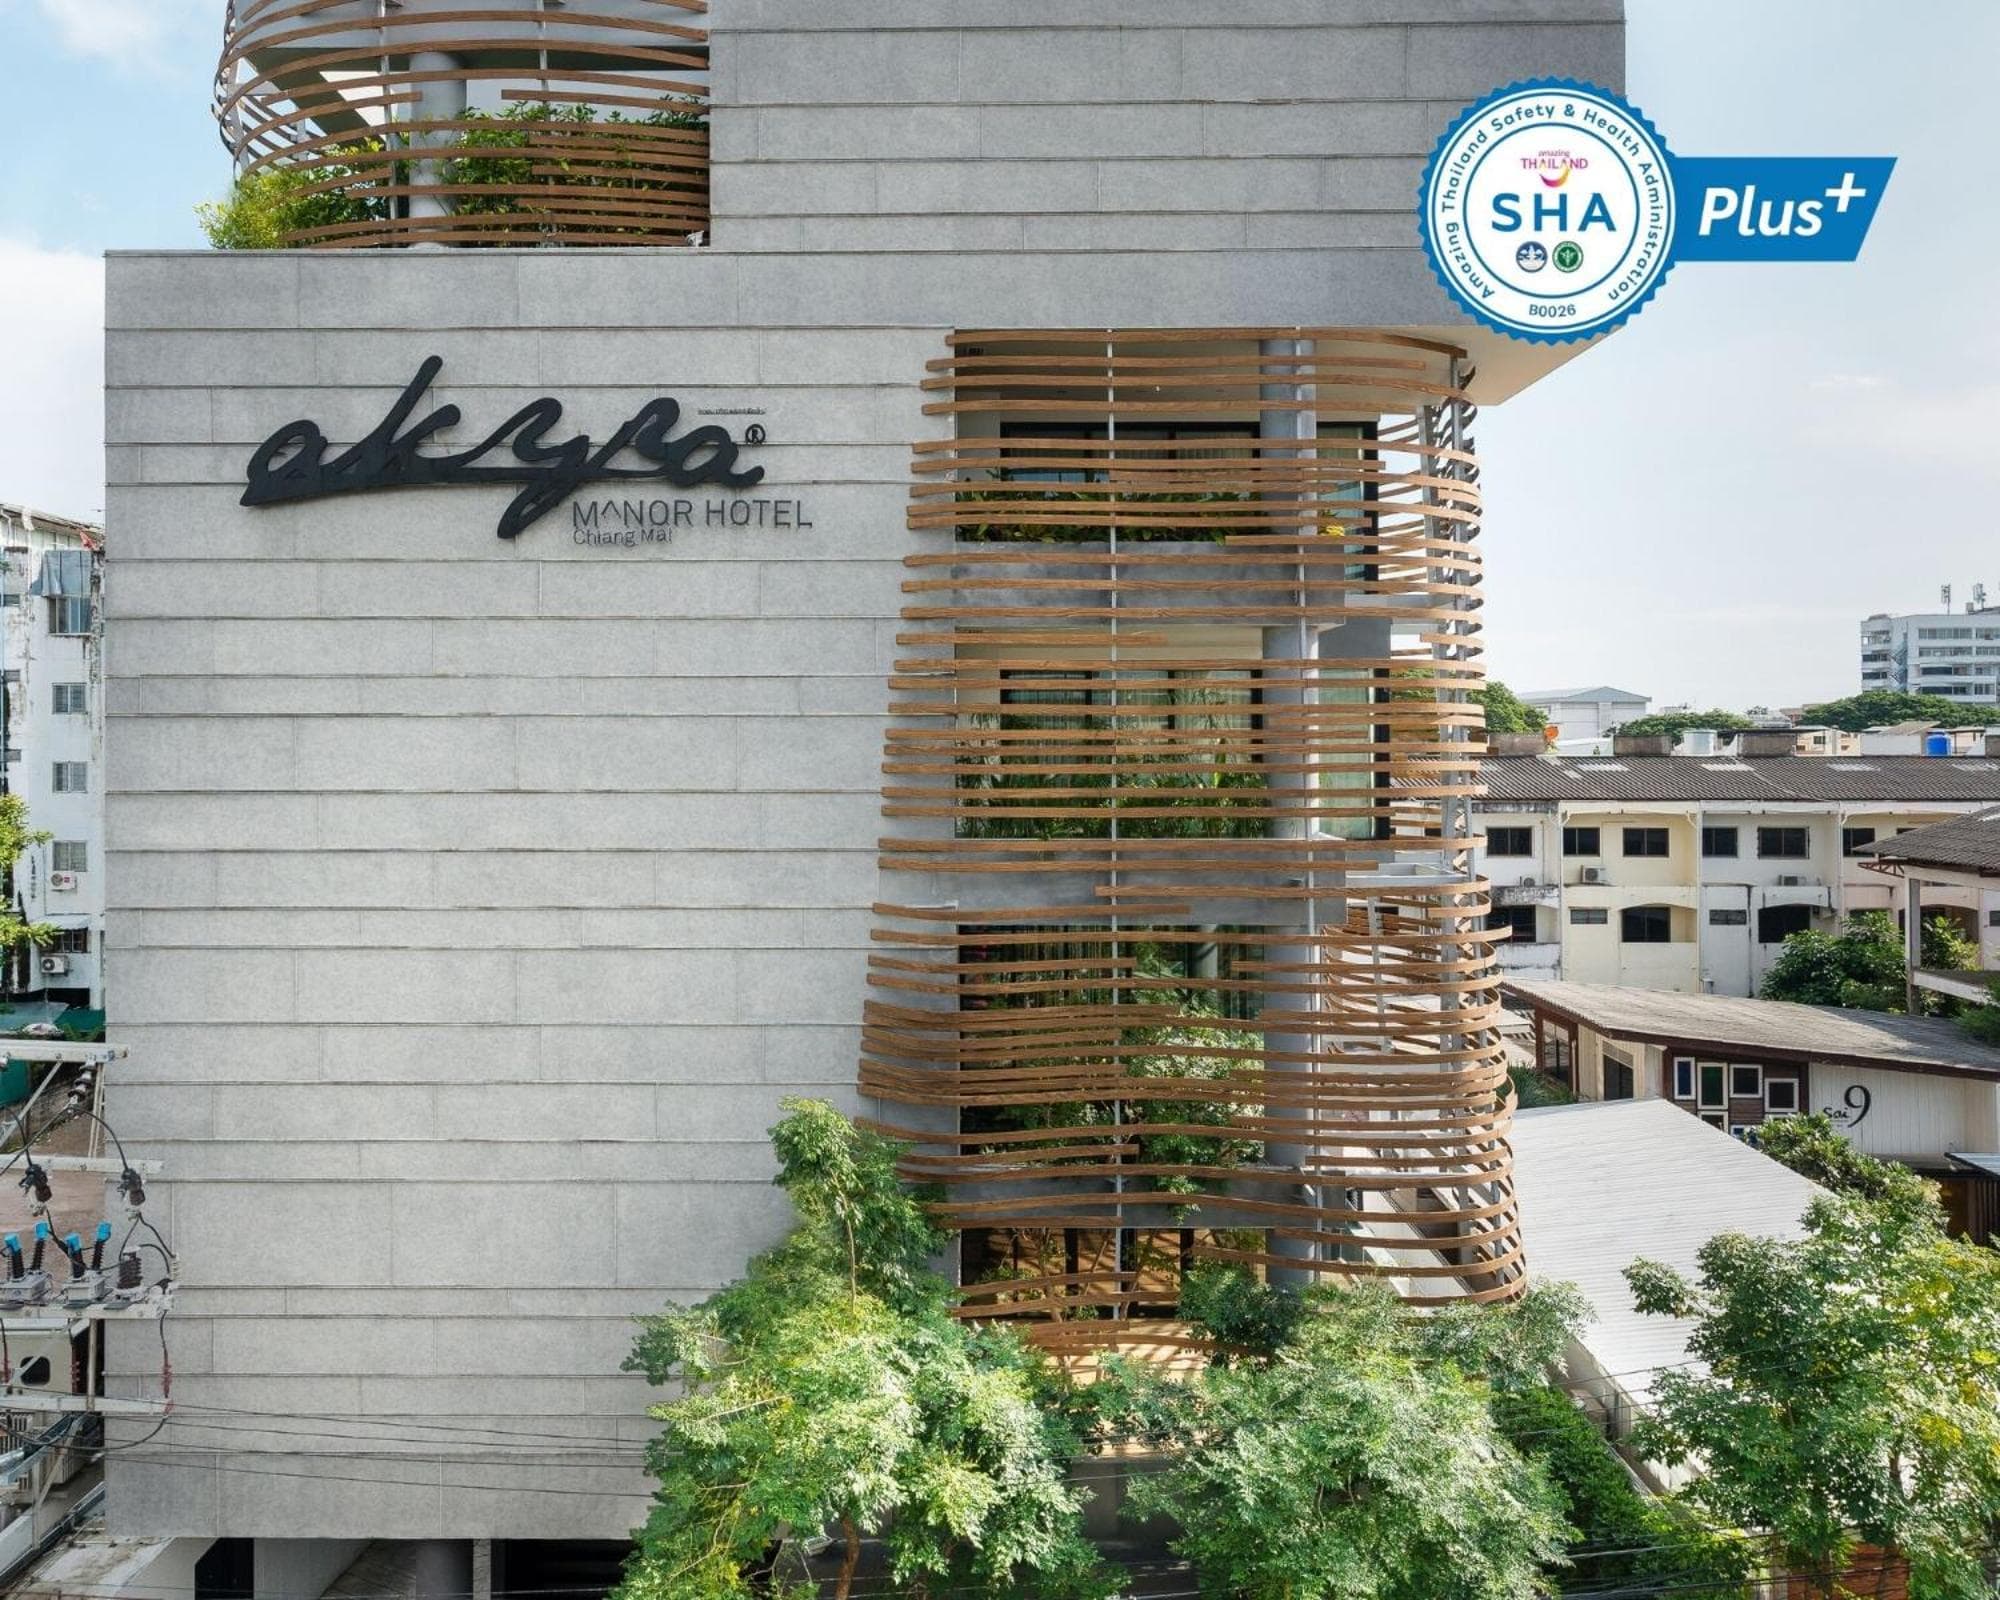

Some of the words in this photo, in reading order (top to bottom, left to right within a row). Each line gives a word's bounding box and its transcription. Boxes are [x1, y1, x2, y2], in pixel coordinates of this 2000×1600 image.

[705, 498, 813, 529] HOTEL
[573, 528, 635, 547] Chiang
[640, 527, 673, 543] Mai
[1844, 1085, 1871, 1128] 9
